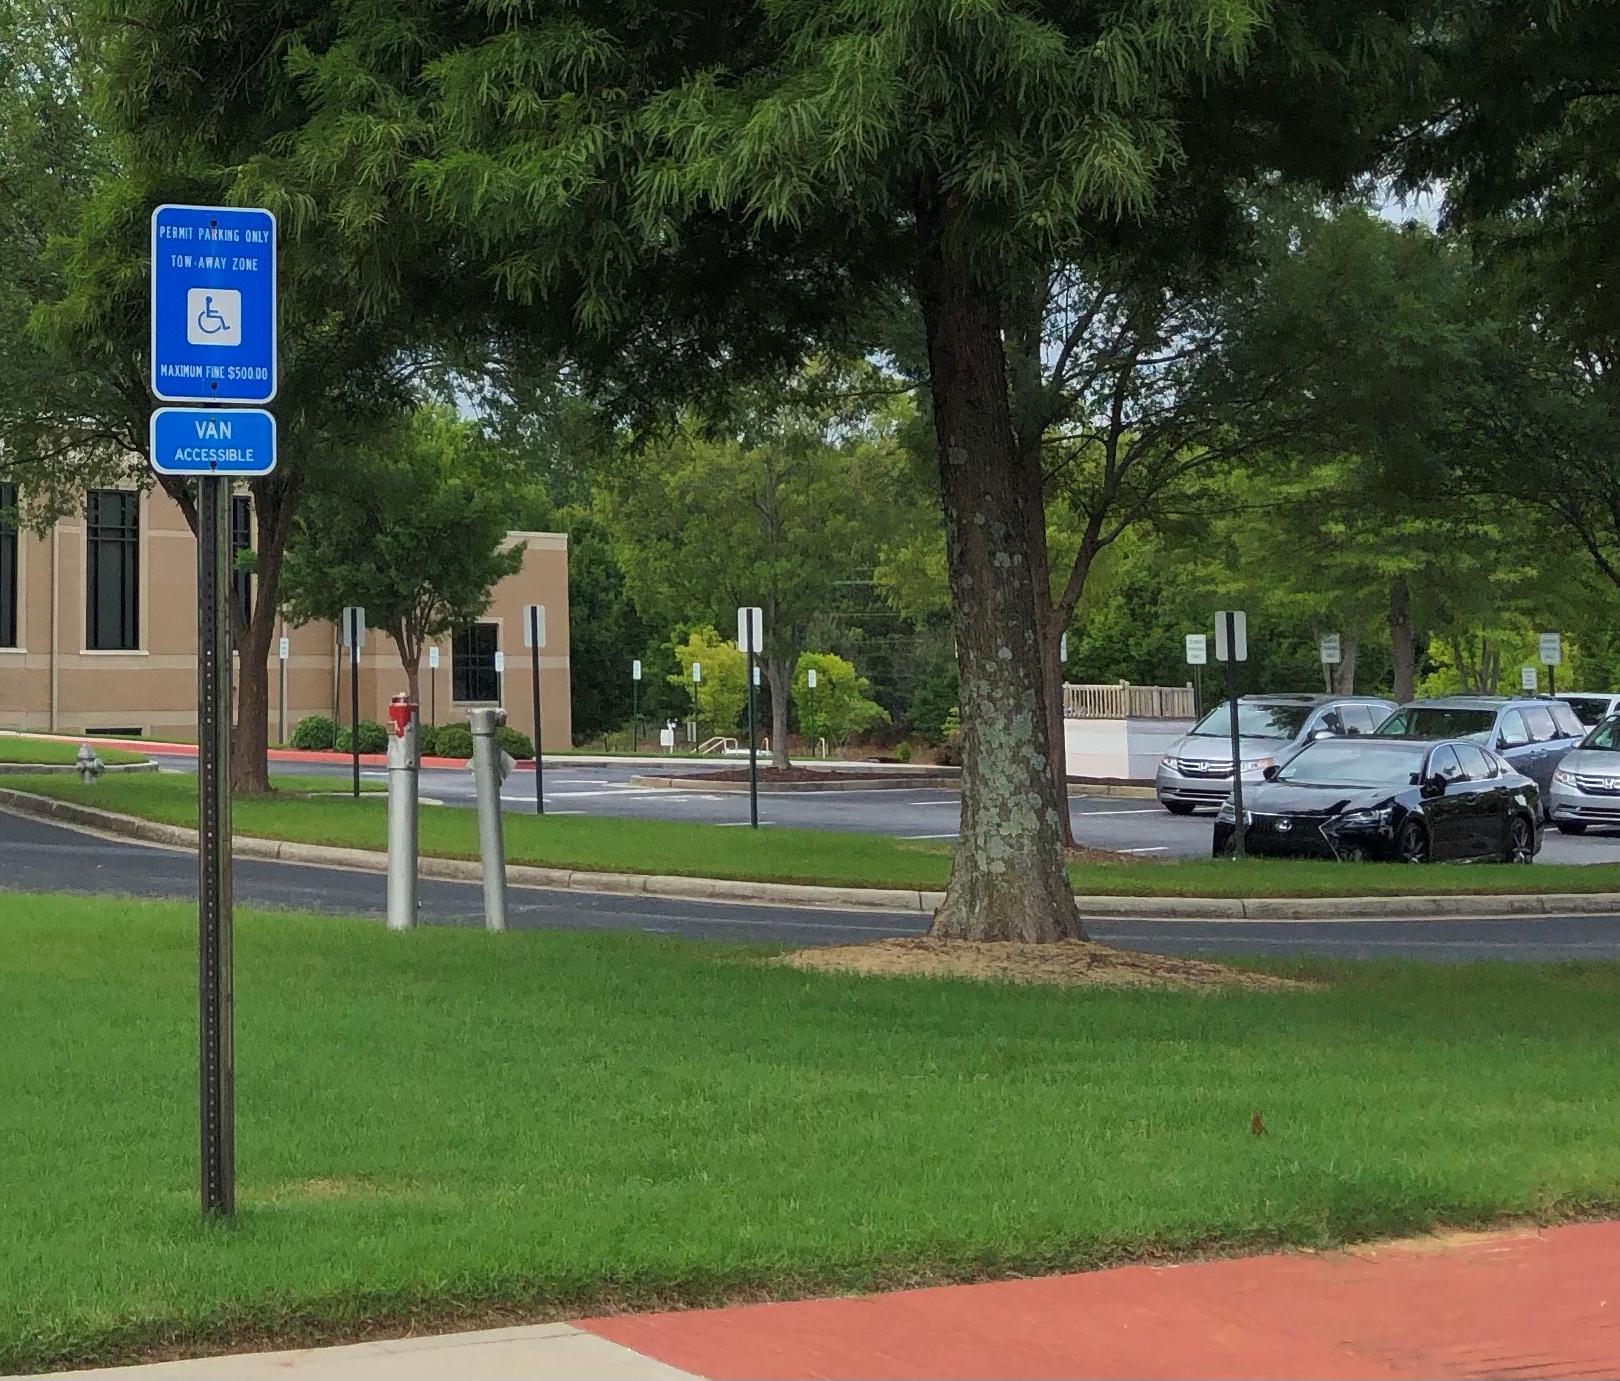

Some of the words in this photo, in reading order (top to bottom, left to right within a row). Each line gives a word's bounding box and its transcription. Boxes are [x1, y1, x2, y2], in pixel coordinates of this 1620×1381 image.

[159, 226, 193, 240] PERMIT
[198, 227, 240, 242] PARKING
[245, 230, 269, 243] ONLY
[171, 255, 227, 269] TOW-AWAY
[232, 258, 258, 271] ZONE
[160, 364, 203, 378] MAXIMUM
[205, 365, 225, 379] FINE
[228, 366, 268, 380] $500.00
[194, 421, 232, 440] VAN
[174, 448, 254, 462] ACCESSIBLE
